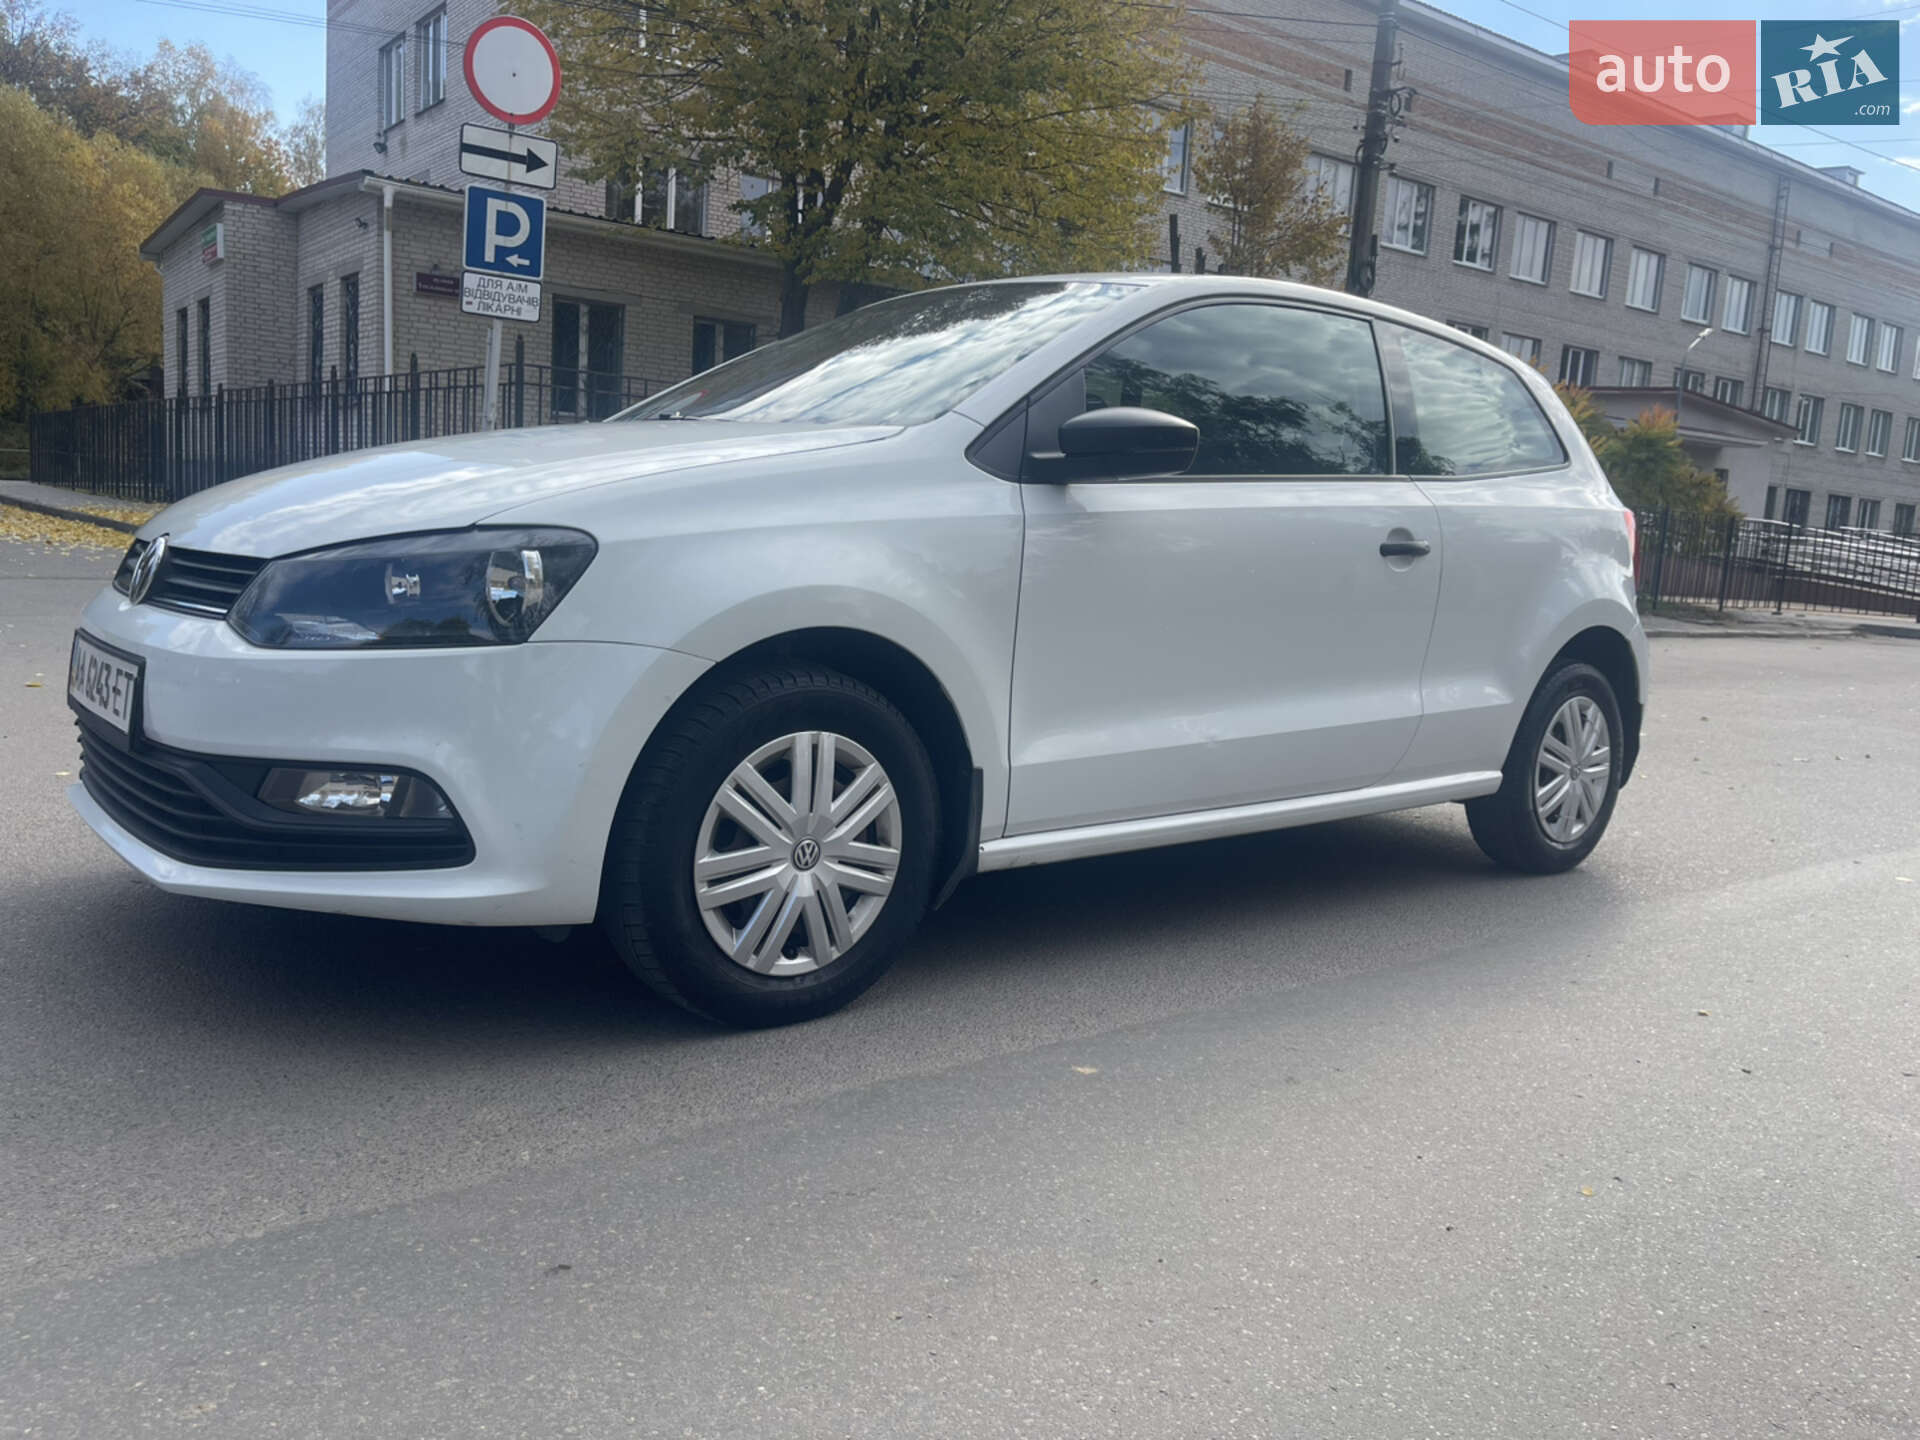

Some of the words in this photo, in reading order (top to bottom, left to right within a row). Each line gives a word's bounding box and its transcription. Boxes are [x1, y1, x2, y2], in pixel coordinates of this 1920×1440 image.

[484, 197, 531, 264] P
[476, 277, 503, 291] ДЛЯ
[463, 286, 540, 309] ВІДВІДУВАЧІВ
[476, 300, 523, 317] ЛІКАРНІ
